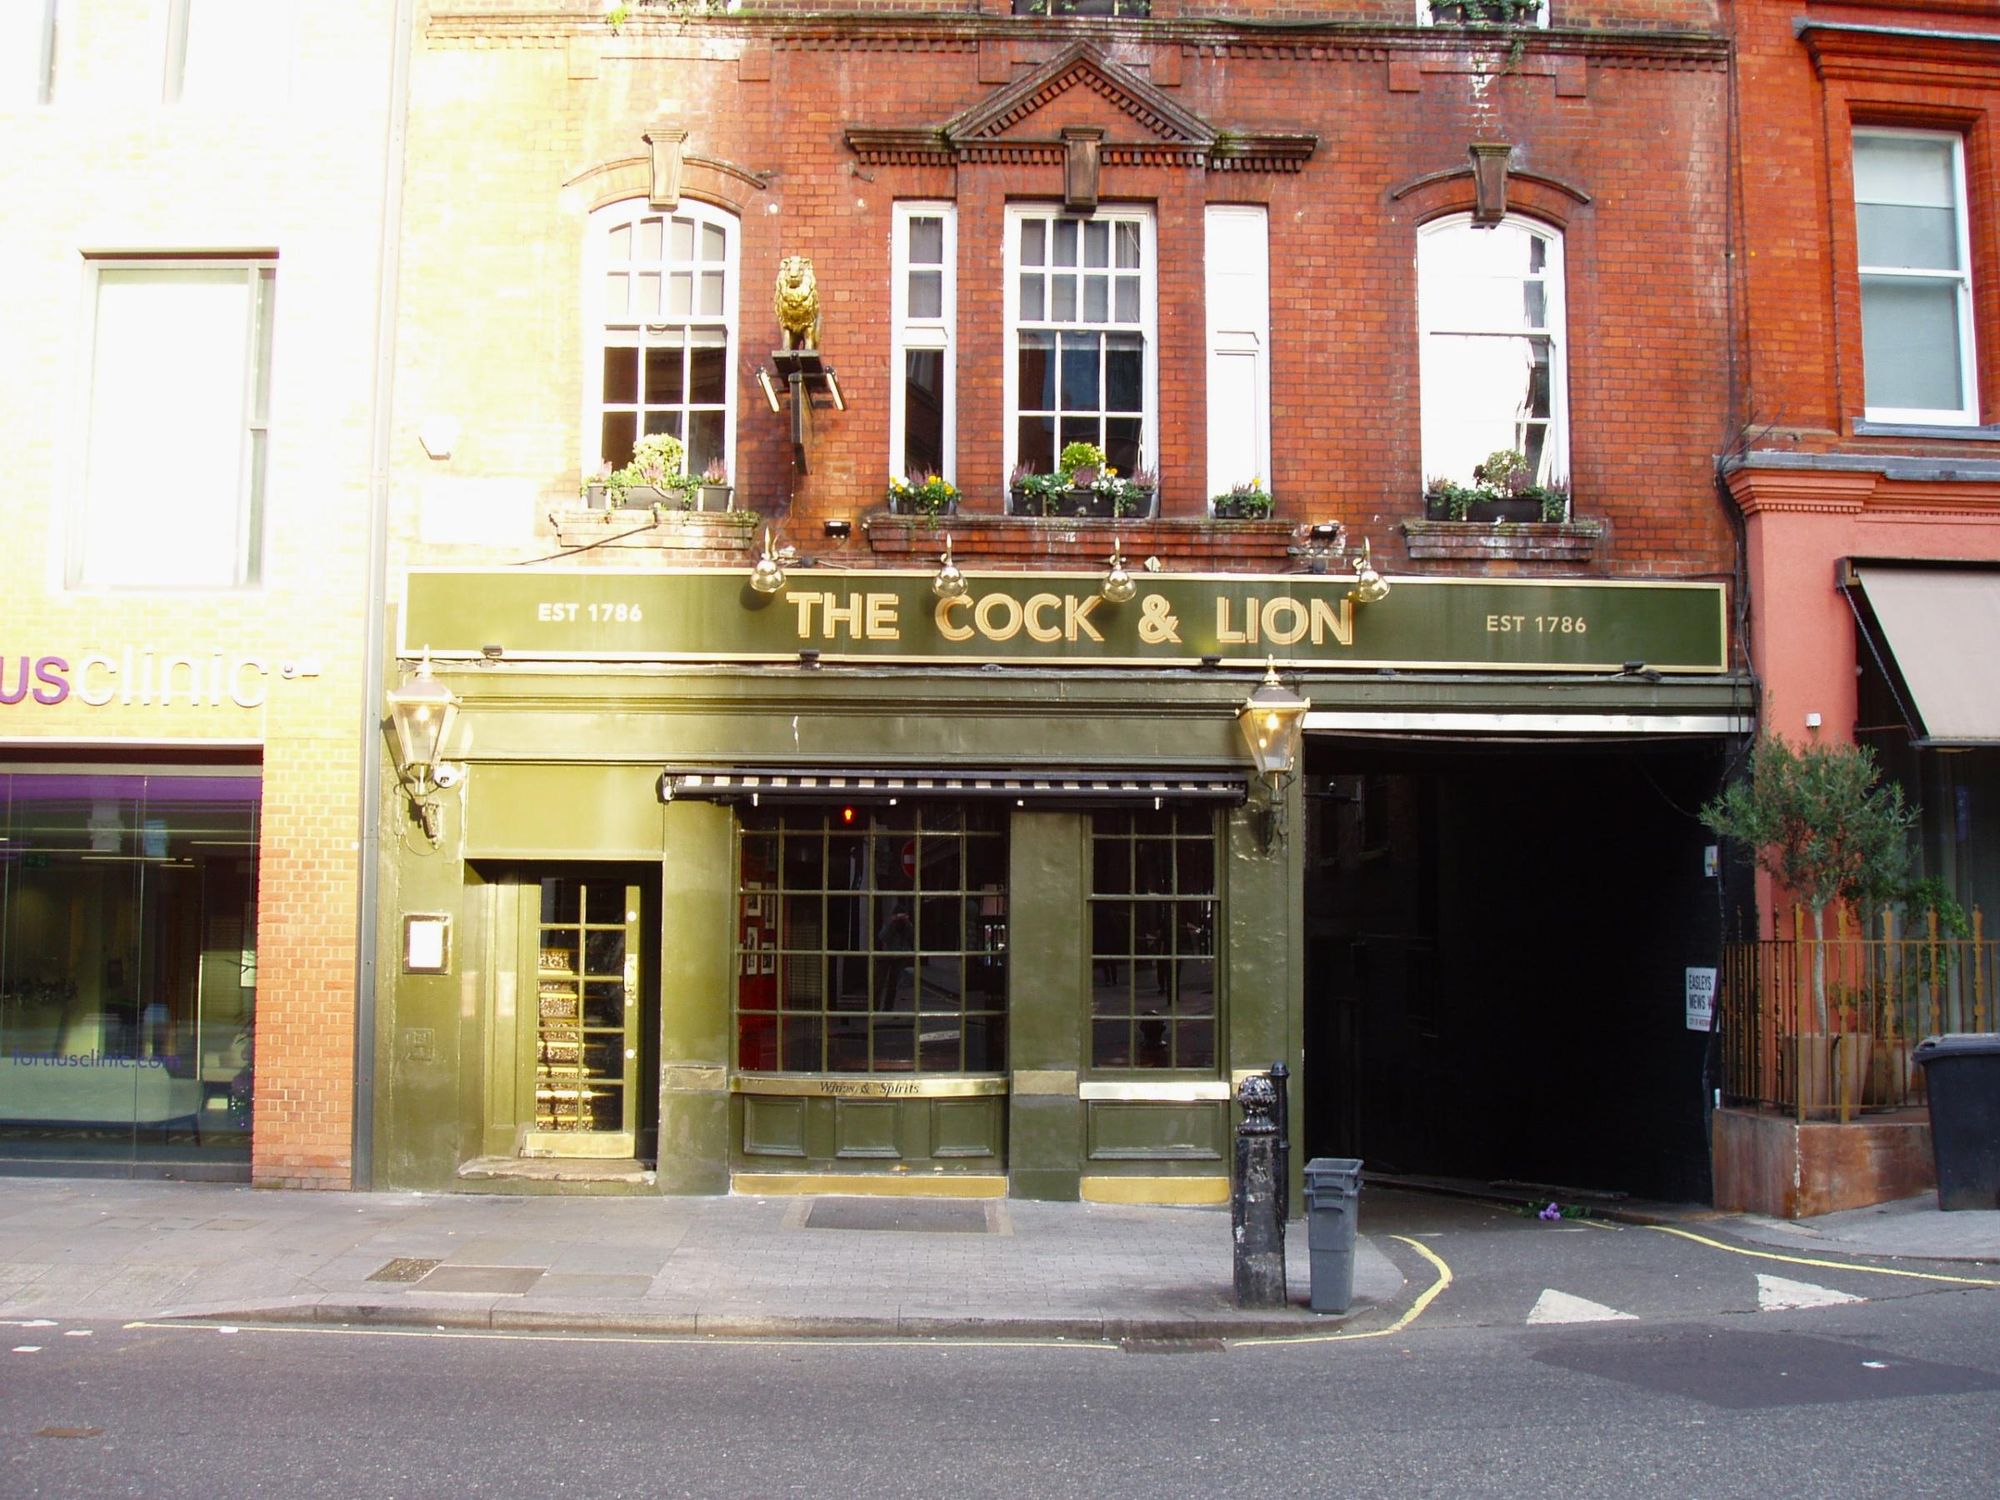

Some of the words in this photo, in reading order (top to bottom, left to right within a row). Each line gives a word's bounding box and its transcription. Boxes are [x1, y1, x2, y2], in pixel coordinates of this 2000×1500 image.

[538, 602, 578, 622] EST
[587, 603, 643, 623] 1786
[786, 592, 900, 640] THE
[934, 592, 1104, 643] COCK
[1138, 594, 1182, 644] &
[1216, 596, 1353, 645] LION
[1486, 615, 1525, 632] EST
[1535, 616, 1587, 633] 1786
[1689, 974, 1712, 991] EASLEYS
[1689, 994, 1706, 1010] MEWS
[12, 1045, 182, 1069] fortiusclinic.com
[860, 1082, 870, 1094] &
[880, 1082, 919, 1098] Spirits
